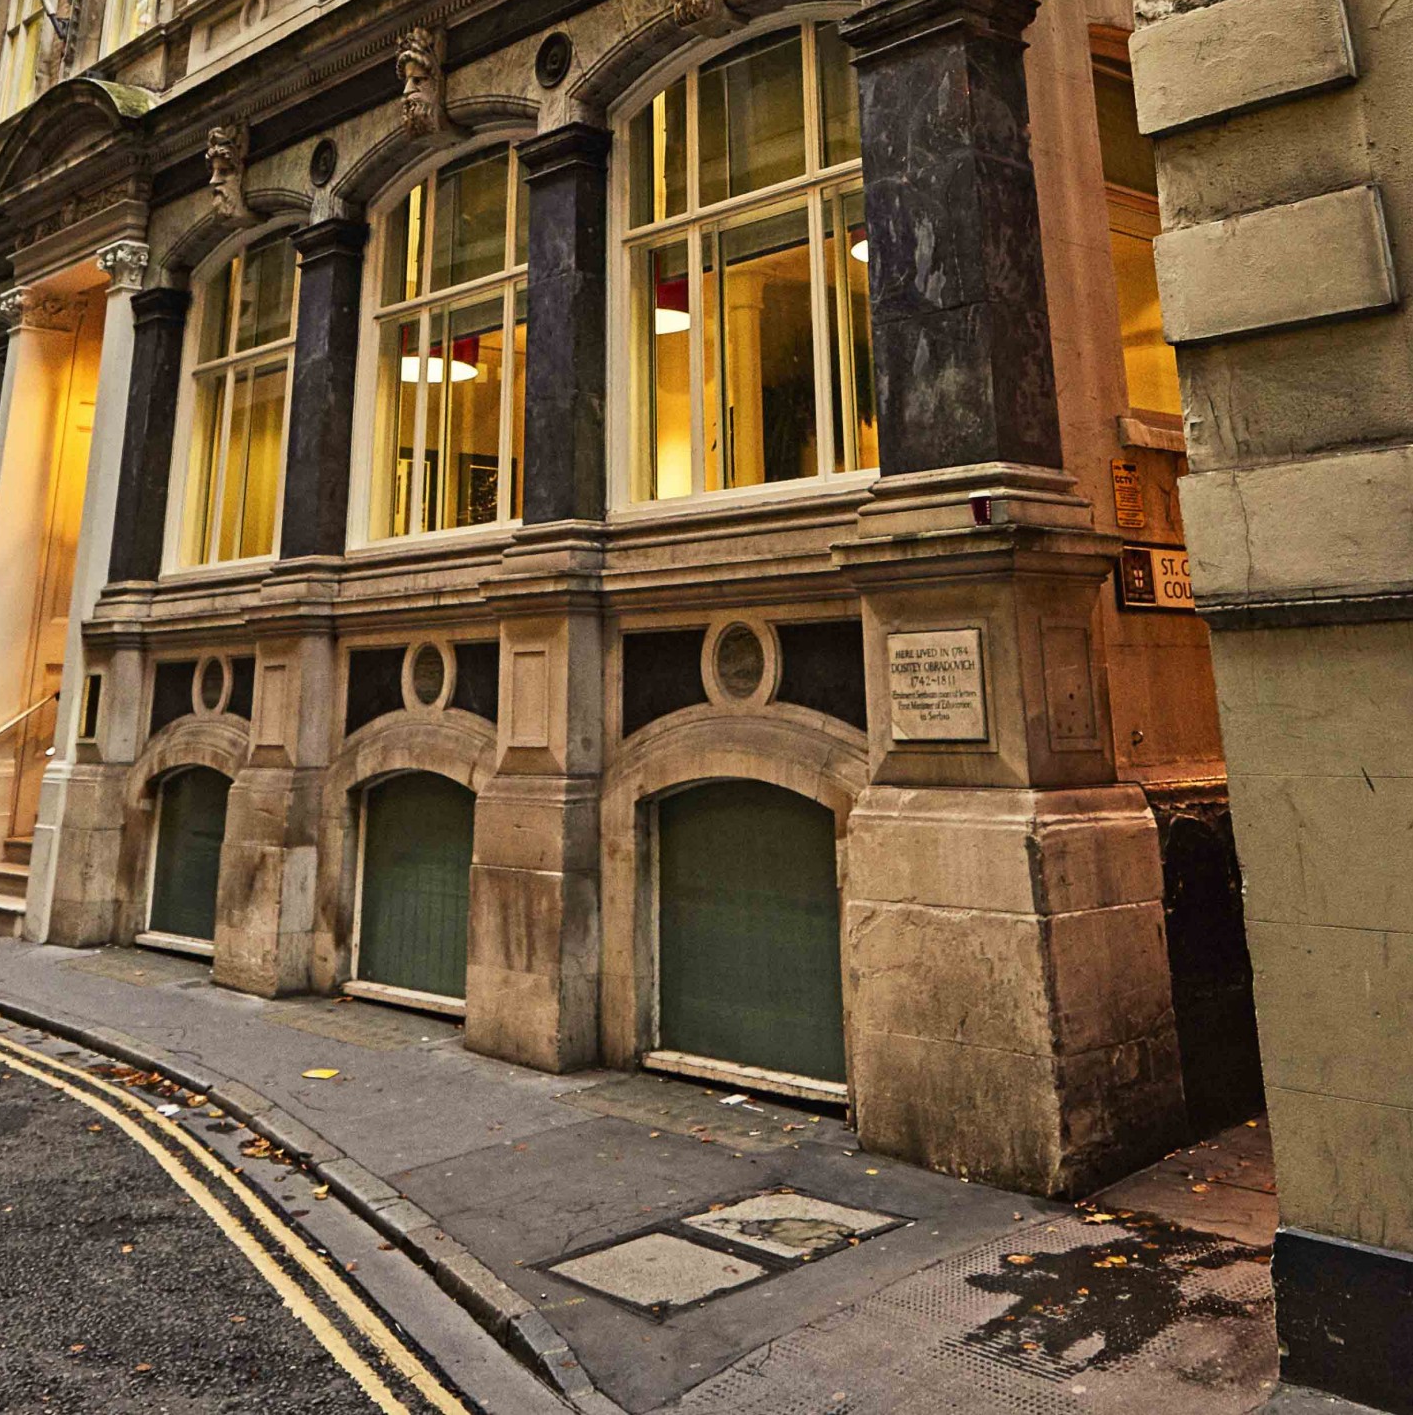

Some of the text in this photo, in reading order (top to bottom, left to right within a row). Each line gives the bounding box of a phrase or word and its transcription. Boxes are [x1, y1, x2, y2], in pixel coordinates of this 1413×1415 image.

[1161, 558, 1178, 576] ST.
[1164, 581, 1192, 599] COU
[895, 649, 914, 659] HERE
[916, 648, 937, 658] LIVED
[940, 648, 949, 657] IN
[891, 660, 975, 673] DOSITEY OBRADOVICH
